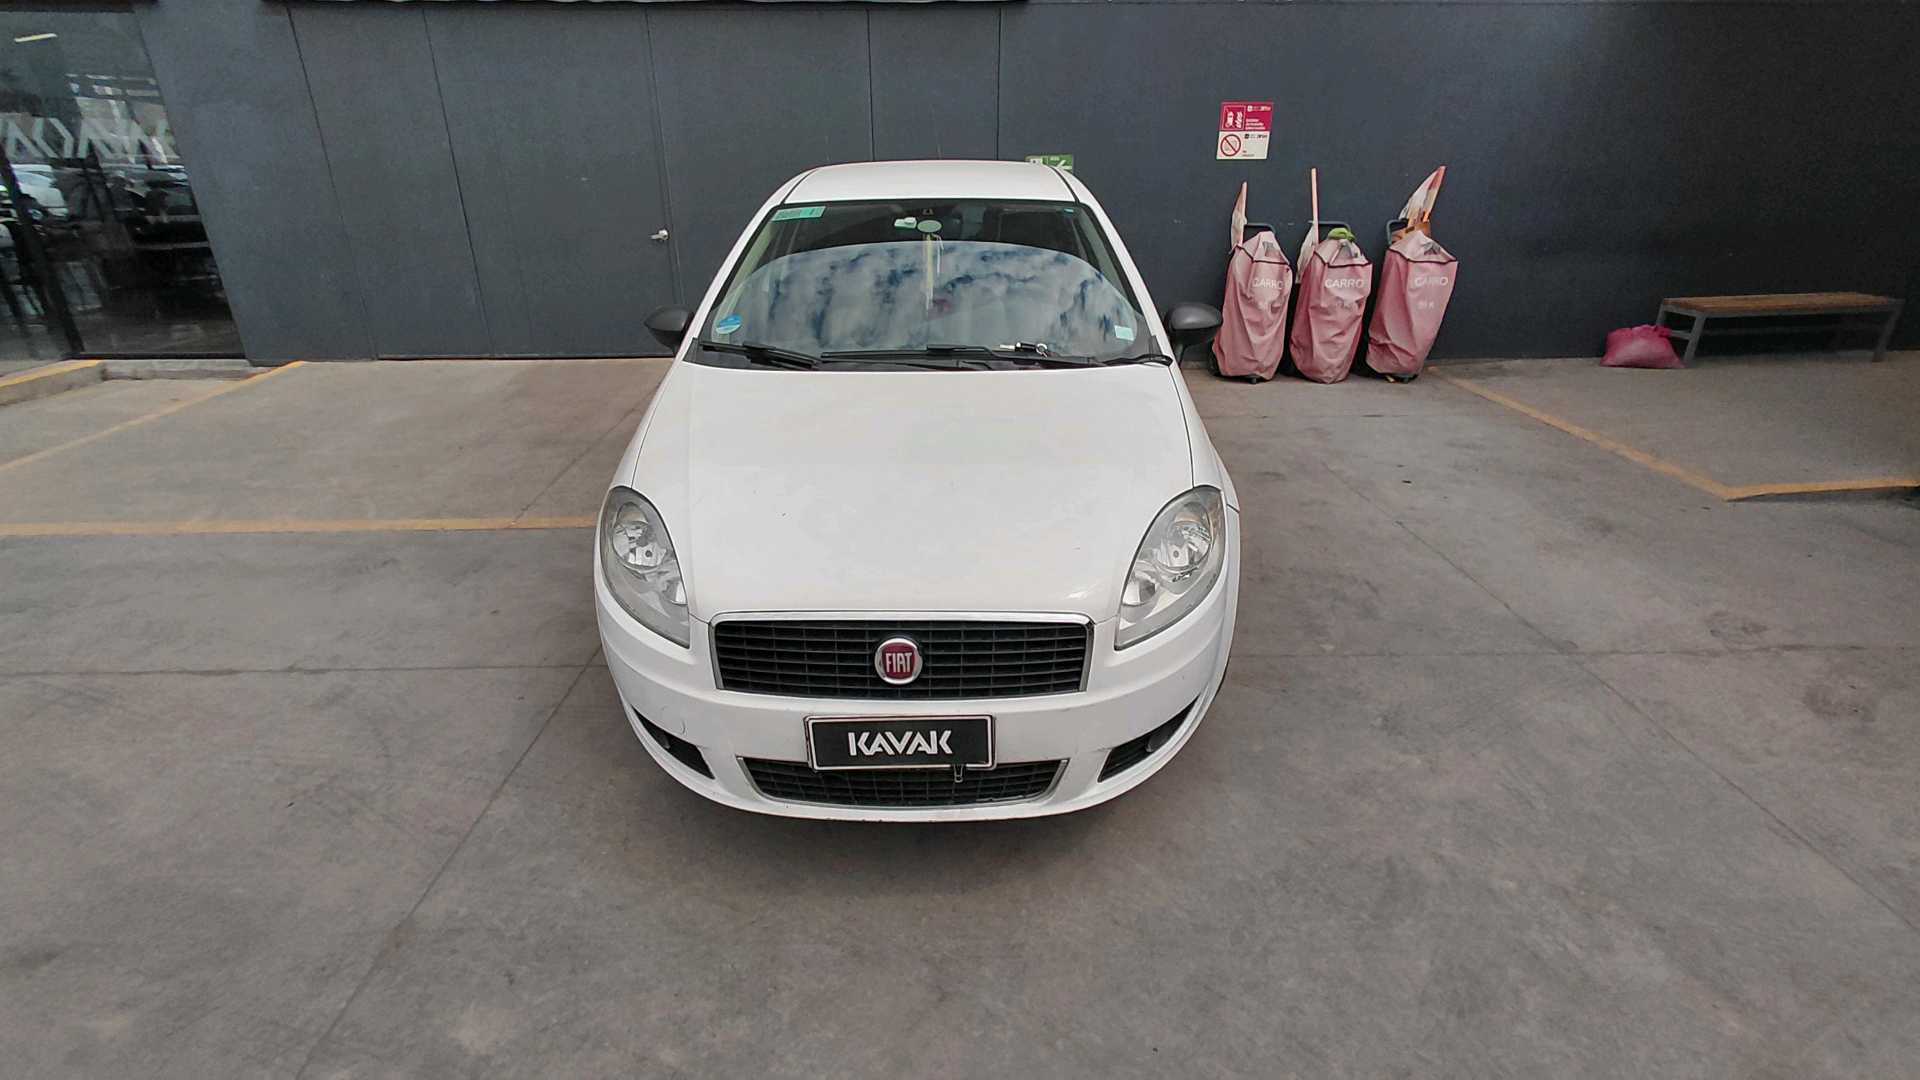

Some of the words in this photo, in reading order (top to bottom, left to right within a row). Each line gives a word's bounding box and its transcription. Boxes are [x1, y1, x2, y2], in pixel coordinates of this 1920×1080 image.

[1325, 278, 1364, 289] CARRO
[885, 652, 913, 673] FIAT
[848, 730, 953, 756] KAVAK
